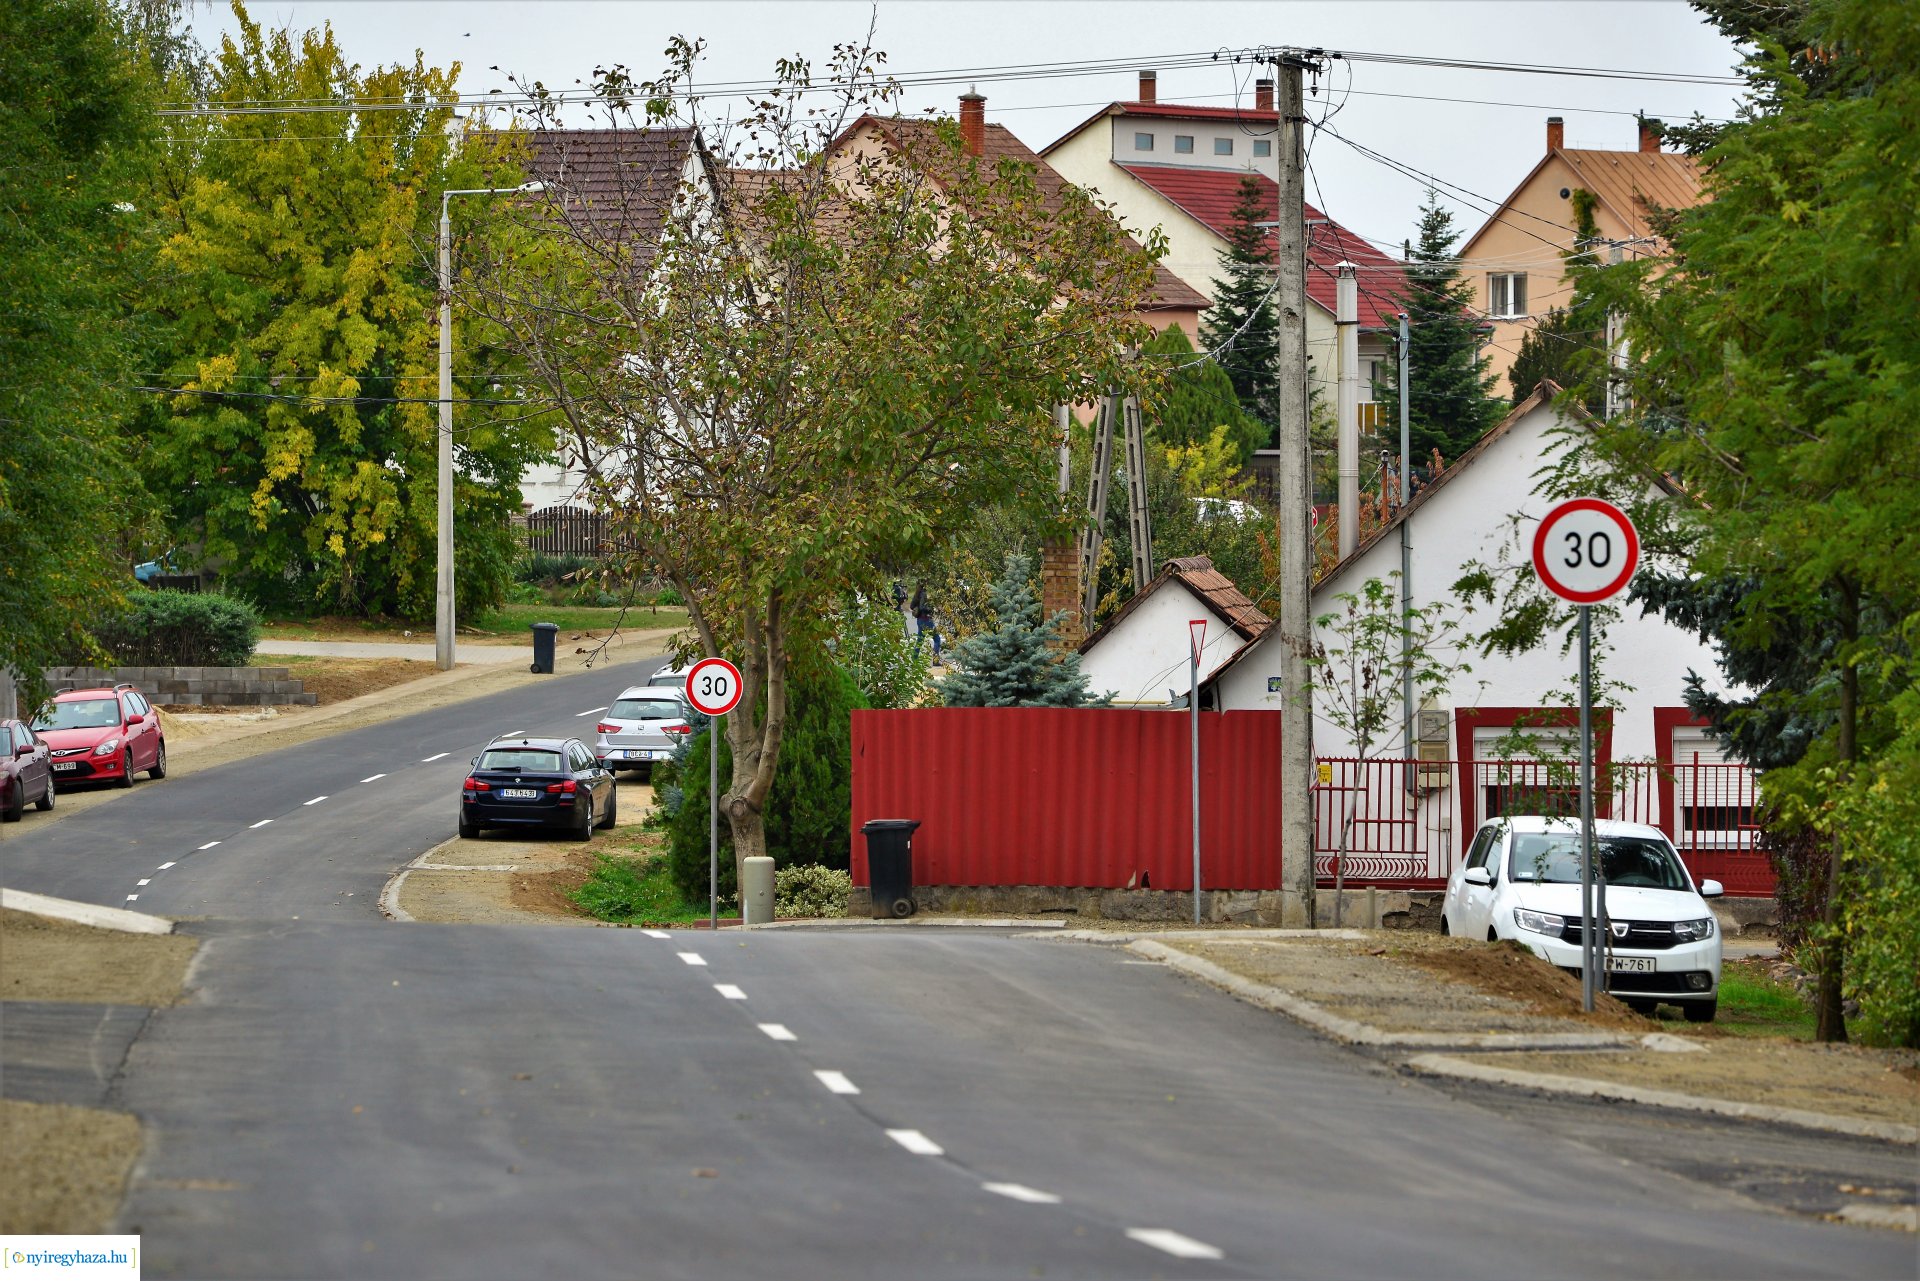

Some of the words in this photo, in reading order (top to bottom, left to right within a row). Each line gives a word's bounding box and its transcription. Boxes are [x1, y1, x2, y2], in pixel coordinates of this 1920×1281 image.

[1564, 531, 1611, 568] 30
[701, 676, 727, 697] 30
[1604, 958, 1651, 971] PW-761
